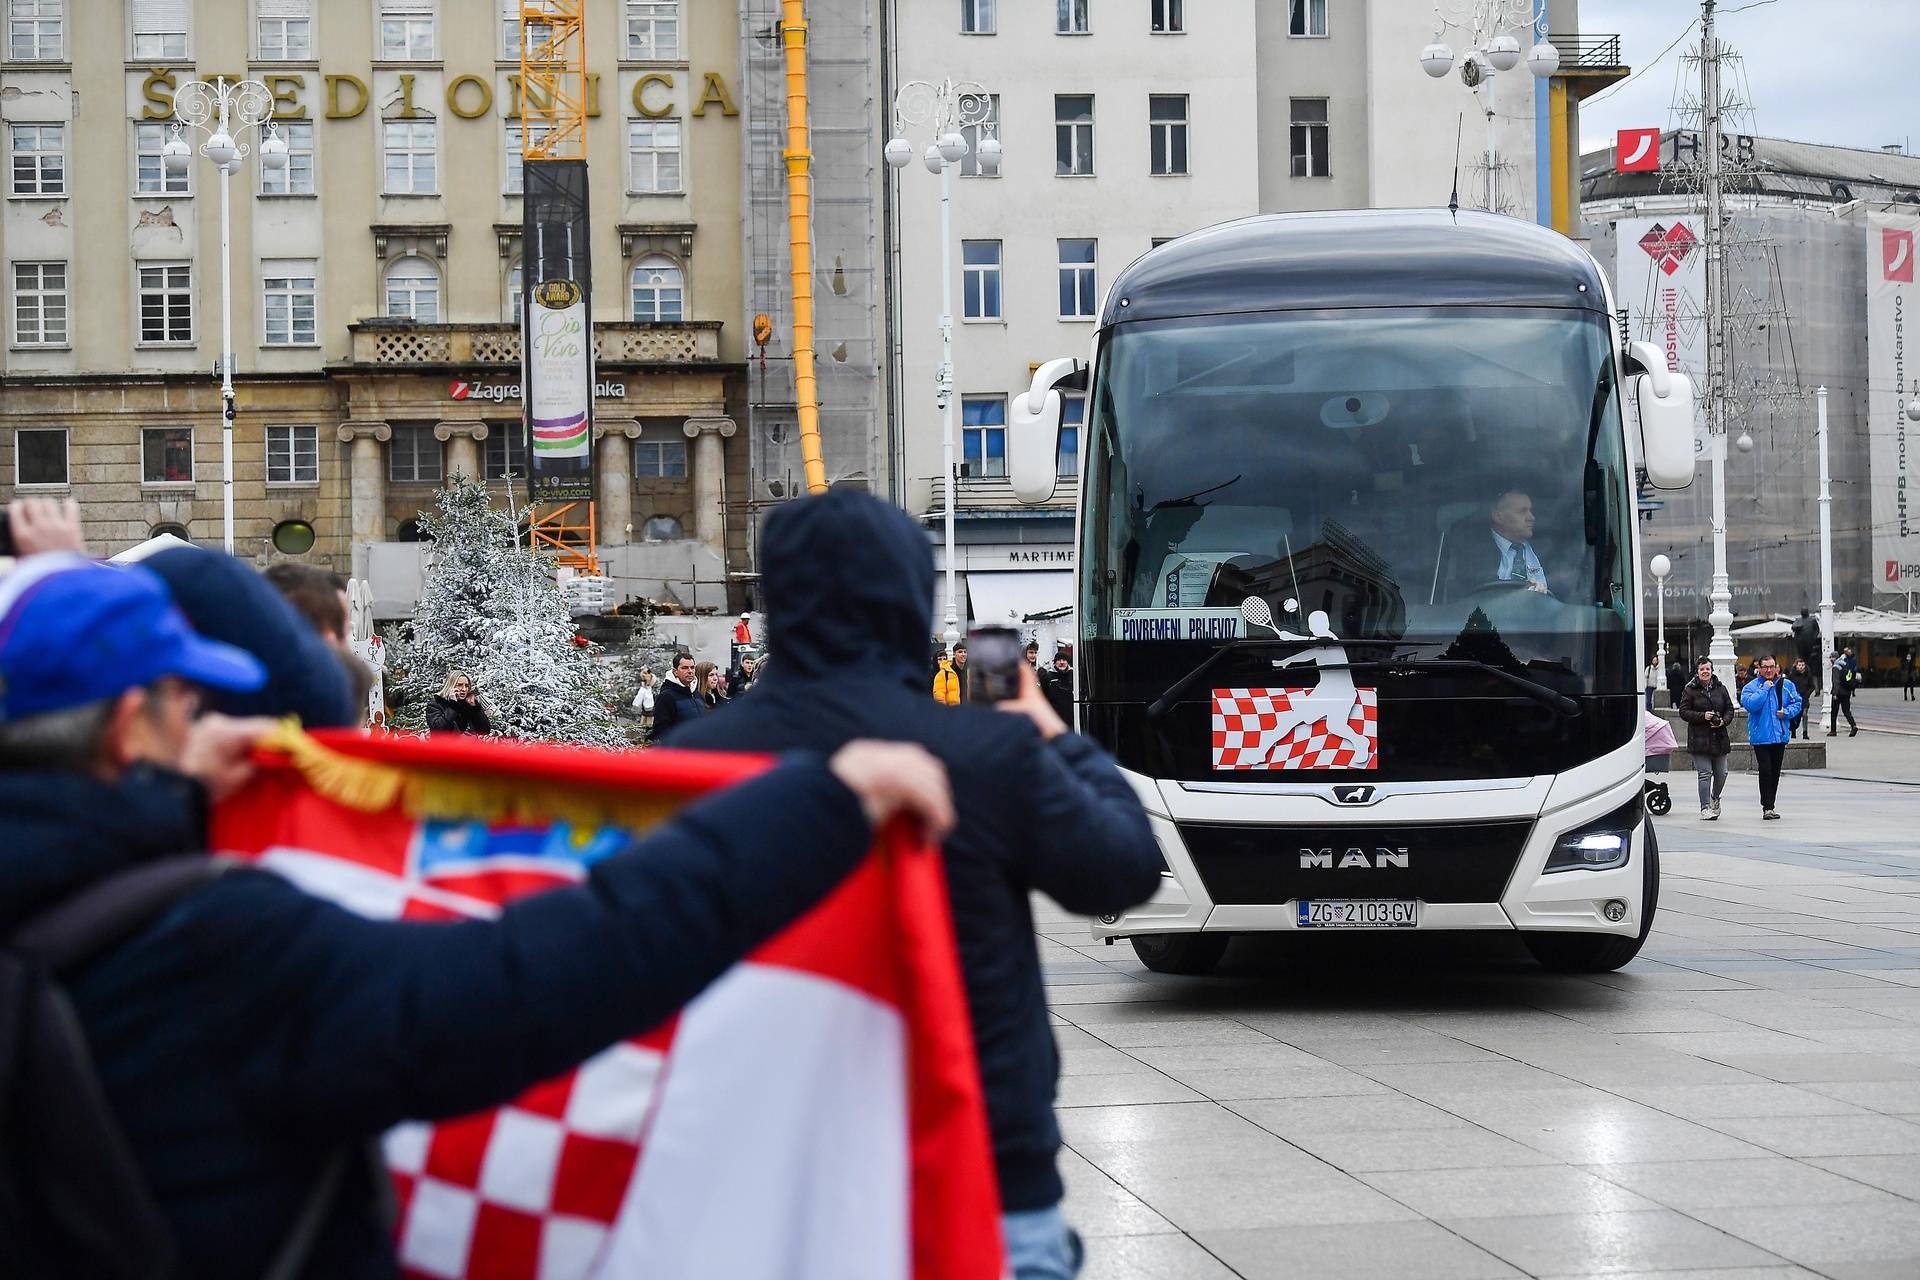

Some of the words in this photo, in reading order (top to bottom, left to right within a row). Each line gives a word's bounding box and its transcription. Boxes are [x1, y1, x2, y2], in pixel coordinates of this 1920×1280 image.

[545, 291, 571, 301] AWARD
[548, 282, 567, 292] GOLD
[1894, 295, 1905, 394] bankarstvo
[472, 381, 524, 403] Zagre
[594, 380, 626, 397] nka
[1896, 398, 1906, 470] mobilno
[1900, 564, 1920, 578] HPB
[1122, 618, 1182, 640] POVREMENI
[1188, 617, 1238, 640] PRIJEVOZ
[1300, 847, 1409, 869] MAN
[1311, 903, 1333, 922] ZG
